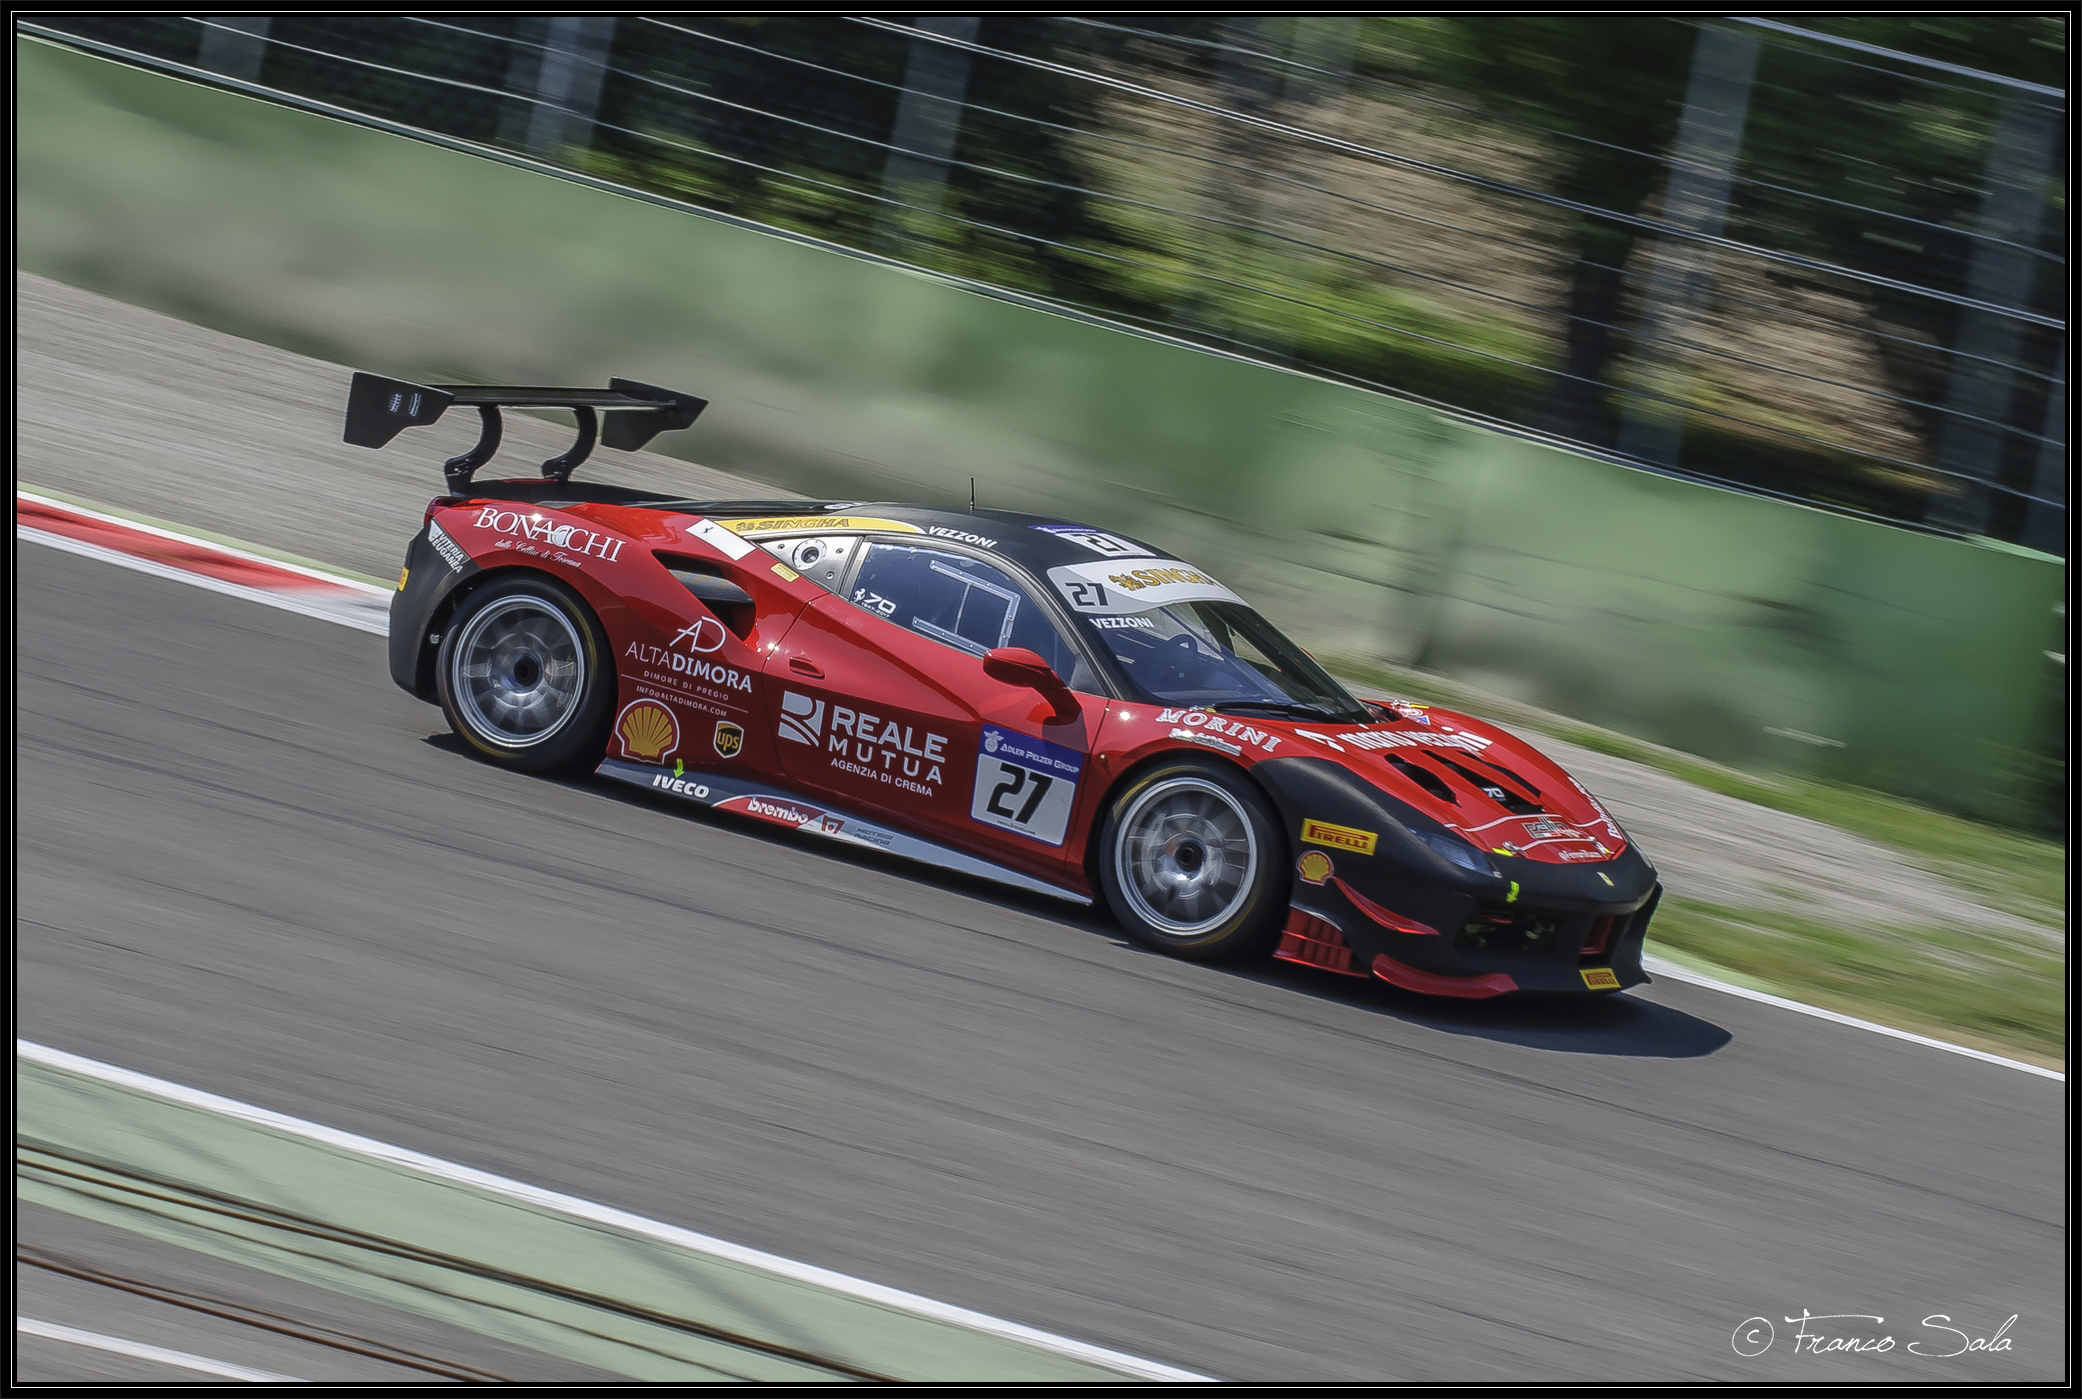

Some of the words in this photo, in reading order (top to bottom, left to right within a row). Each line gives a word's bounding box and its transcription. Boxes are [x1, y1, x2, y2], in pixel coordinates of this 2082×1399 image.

[473, 507, 628, 564] BONACCHI
[757, 518, 850, 531] SINGHA
[927, 525, 999, 549] VEZZONI
[431, 538, 464, 574] EUGANEA
[863, 591, 897, 615] 70
[1064, 582, 1109, 607] 27
[1089, 616, 1156, 630] VEZZONI
[625, 641, 753, 693] ALTADIMORA
[635, 685, 728, 717] INFO@ALTADIMORA.COM
[643, 670, 679, 686] DIMORE
[682, 680, 693, 690] DI
[696, 685, 730, 701] PREGIO
[716, 732, 740, 752] ups
[831, 704, 949, 764] REALE
[1155, 707, 1283, 752] MORINI
[828, 734, 944, 786] MUTUA
[1000, 743, 1025, 757] ADLER
[1025, 751, 1053, 766] PELZER
[1053, 760, 1080, 774] GROUP
[652, 773, 710, 798] IVECO
[830, 758, 878, 780] AGENZIA
[880, 771, 893, 785] DI
[894, 777, 933, 797] CREMA
[986, 761, 1054, 825] 27
[747, 796, 809, 824] brembo
[1309, 824, 1370, 850] PIRELLI
